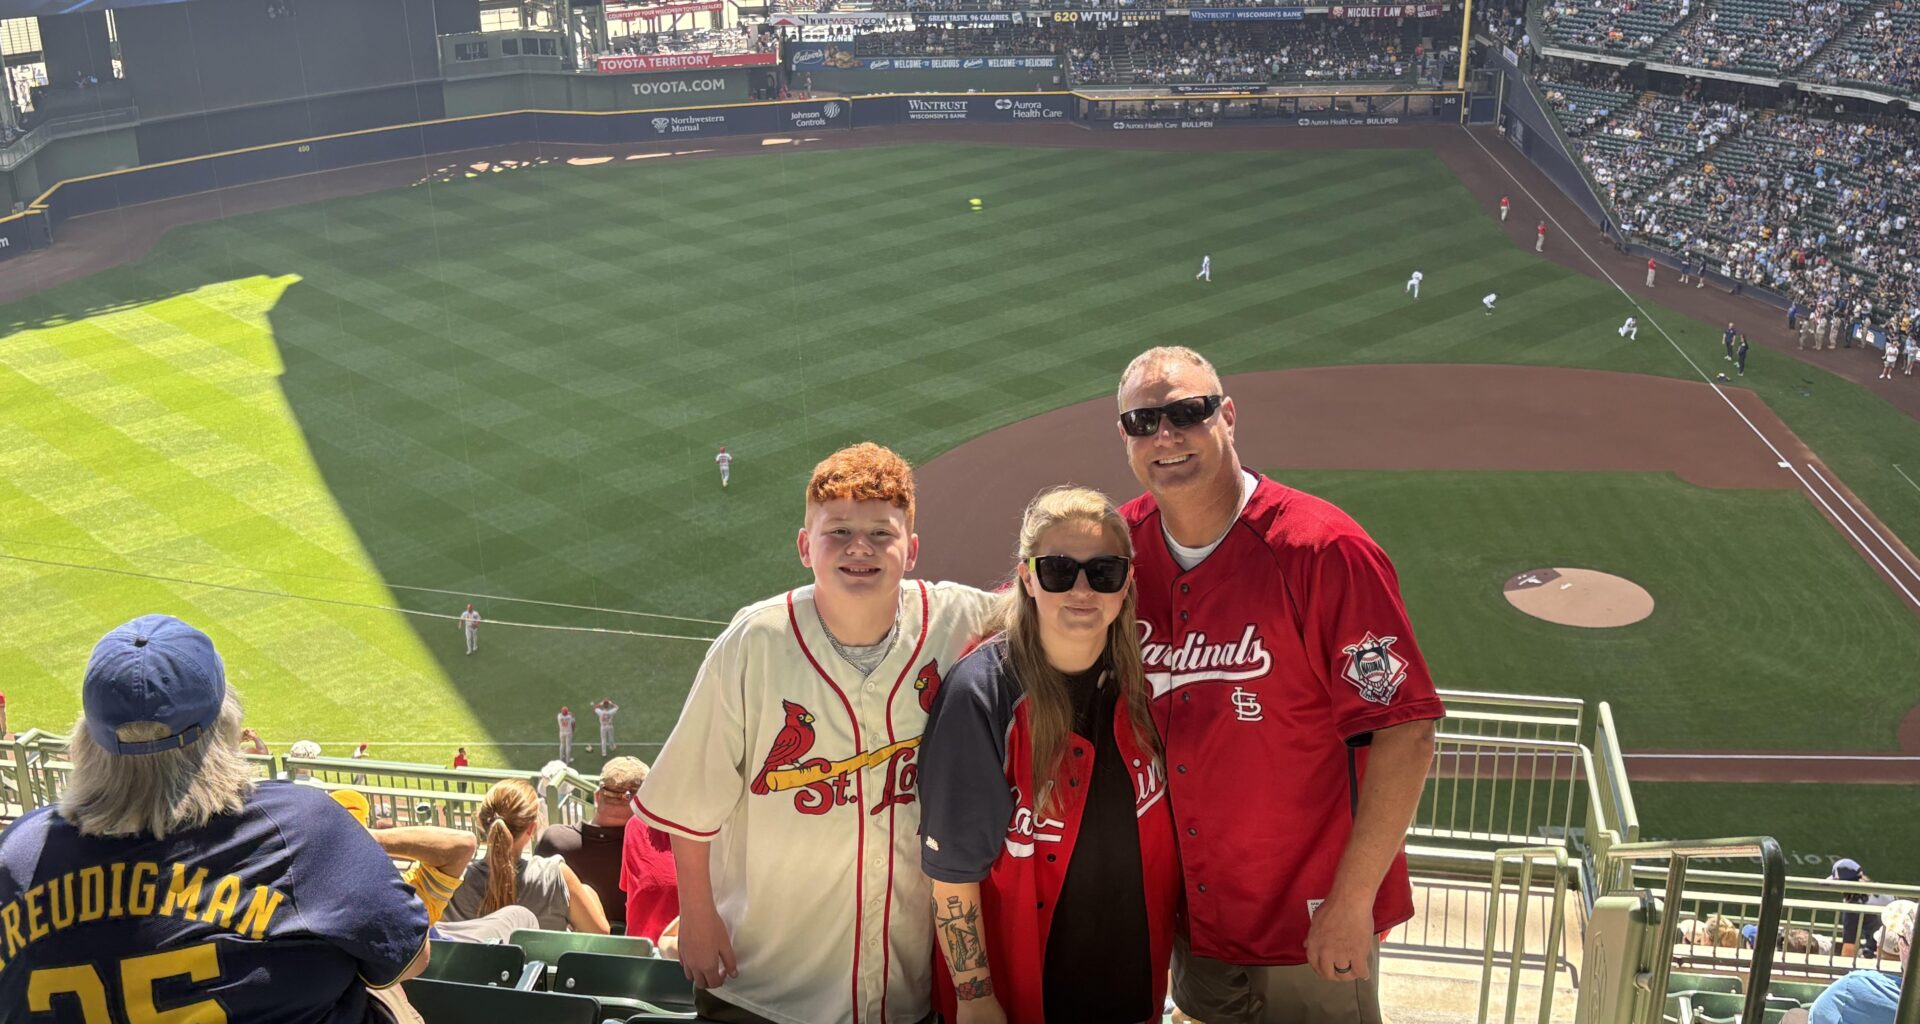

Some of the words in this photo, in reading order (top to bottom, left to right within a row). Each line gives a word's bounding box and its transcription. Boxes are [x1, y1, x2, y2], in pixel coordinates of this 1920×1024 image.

[1054, 12, 1078, 22] 620
[1080, 11, 1119, 21] WTMJ
[1348, 7, 1381, 17] NICOLET
[1384, 7, 1402, 16] LAW
[600, 59, 646, 70] TOYOTA
[648, 55, 710, 67] TERRITORY
[894, 59, 922, 69] WELCOME
[931, 59, 960, 68] DELICIOUS
[988, 58, 1016, 68] WELCOME
[1024, 58, 1054, 67] DELICIOUS
[632, 78, 726, 96] TOYOTA.COM
[908, 100, 968, 110] WINTRUST
[1014, 100, 1042, 109] Aurora
[791, 110, 820, 120] Johnson
[1013, 109, 1040, 118] Health
[1042, 109, 1062, 118] Care
[671, 116, 725, 125] Northwestern
[796, 118, 826, 128] Controls
[672, 124, 700, 132] Mutual
[794, 758, 858, 815] St.
